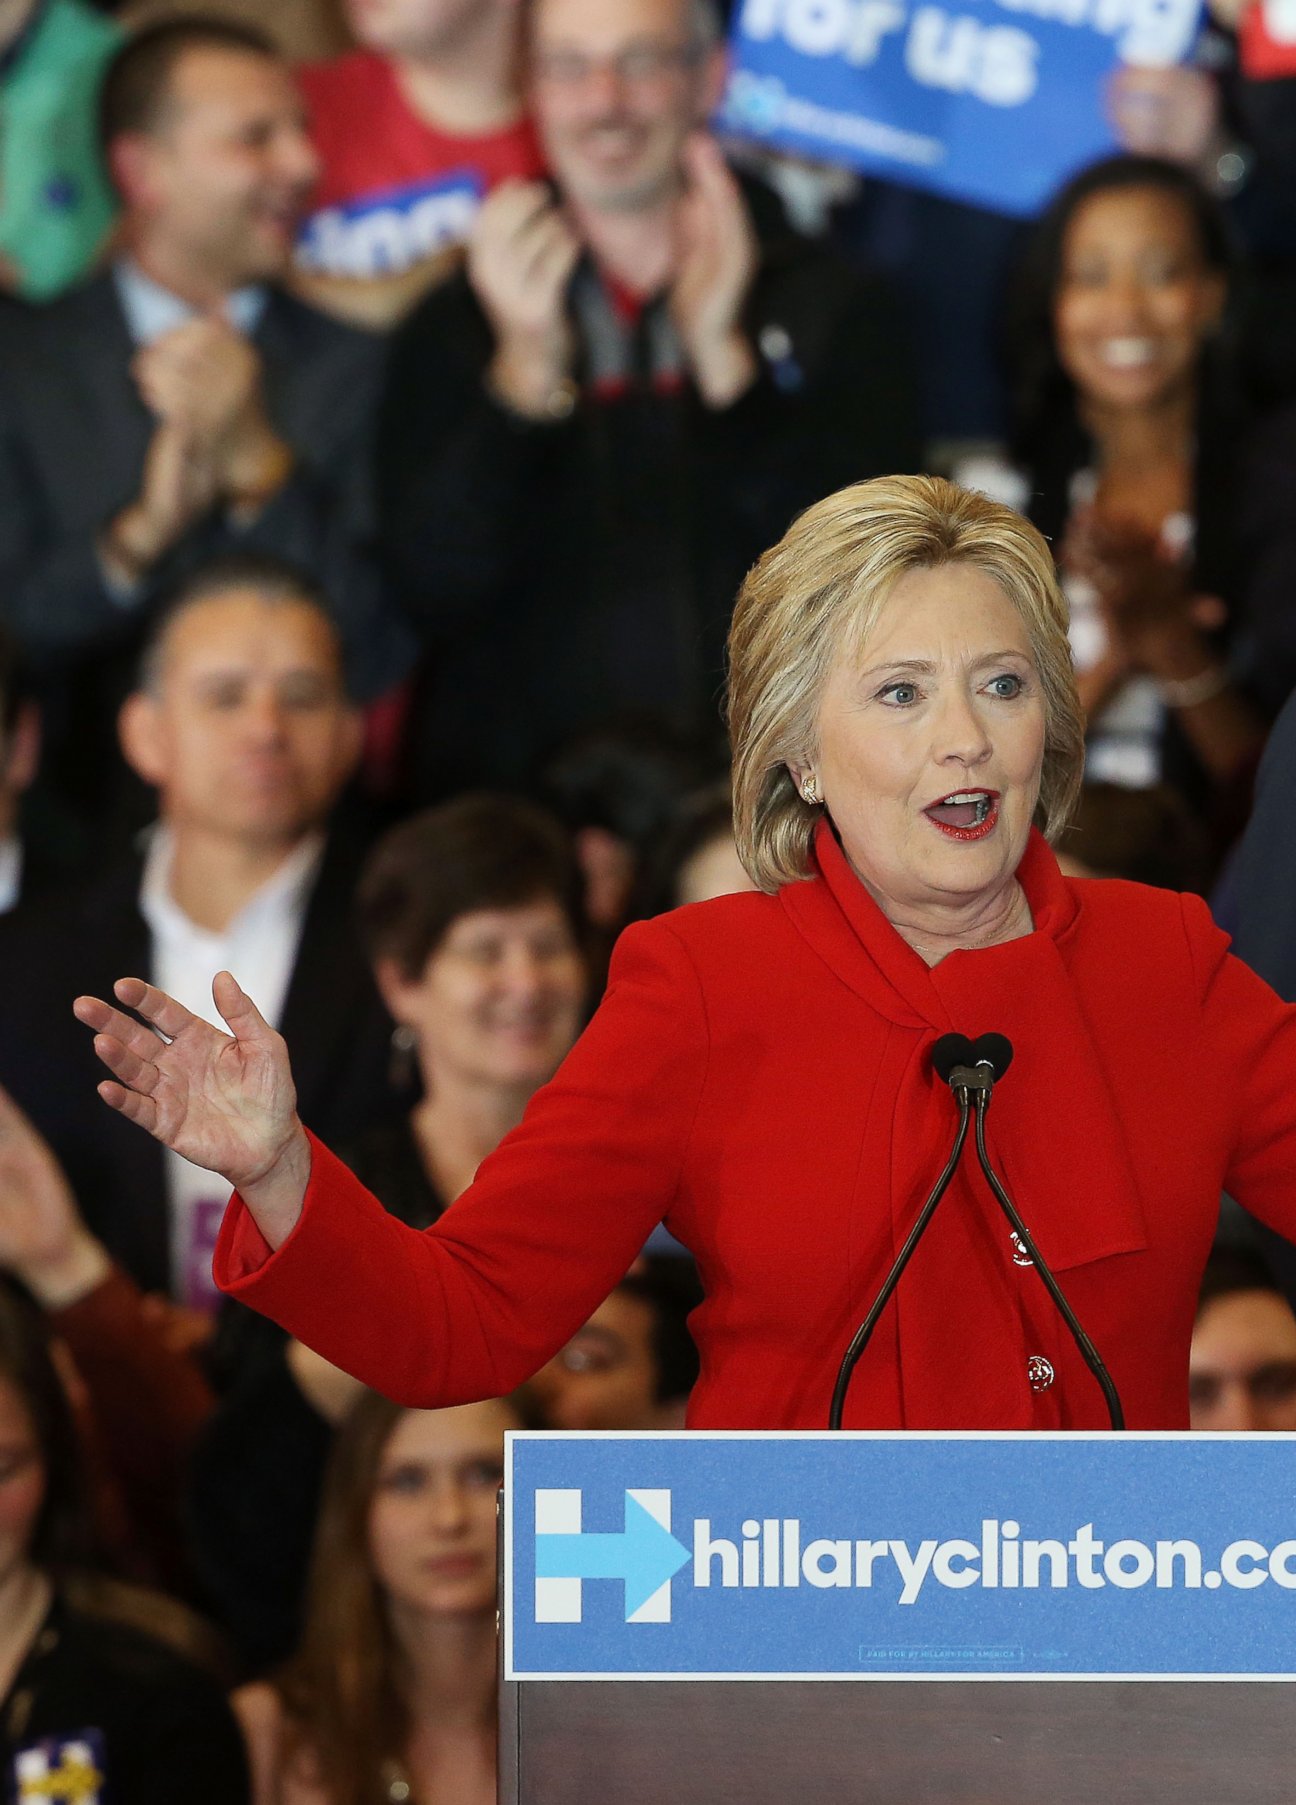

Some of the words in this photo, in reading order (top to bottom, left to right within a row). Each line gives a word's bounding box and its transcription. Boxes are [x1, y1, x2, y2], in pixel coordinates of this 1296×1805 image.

[904, 5, 1039, 107] us
[889, 1650, 906, 1659] FOR
[921, 1650, 955, 1659] HILLARY
[957, 1650, 974, 1659] FOR
[976, 1650, 1015, 1659] AMERICA
